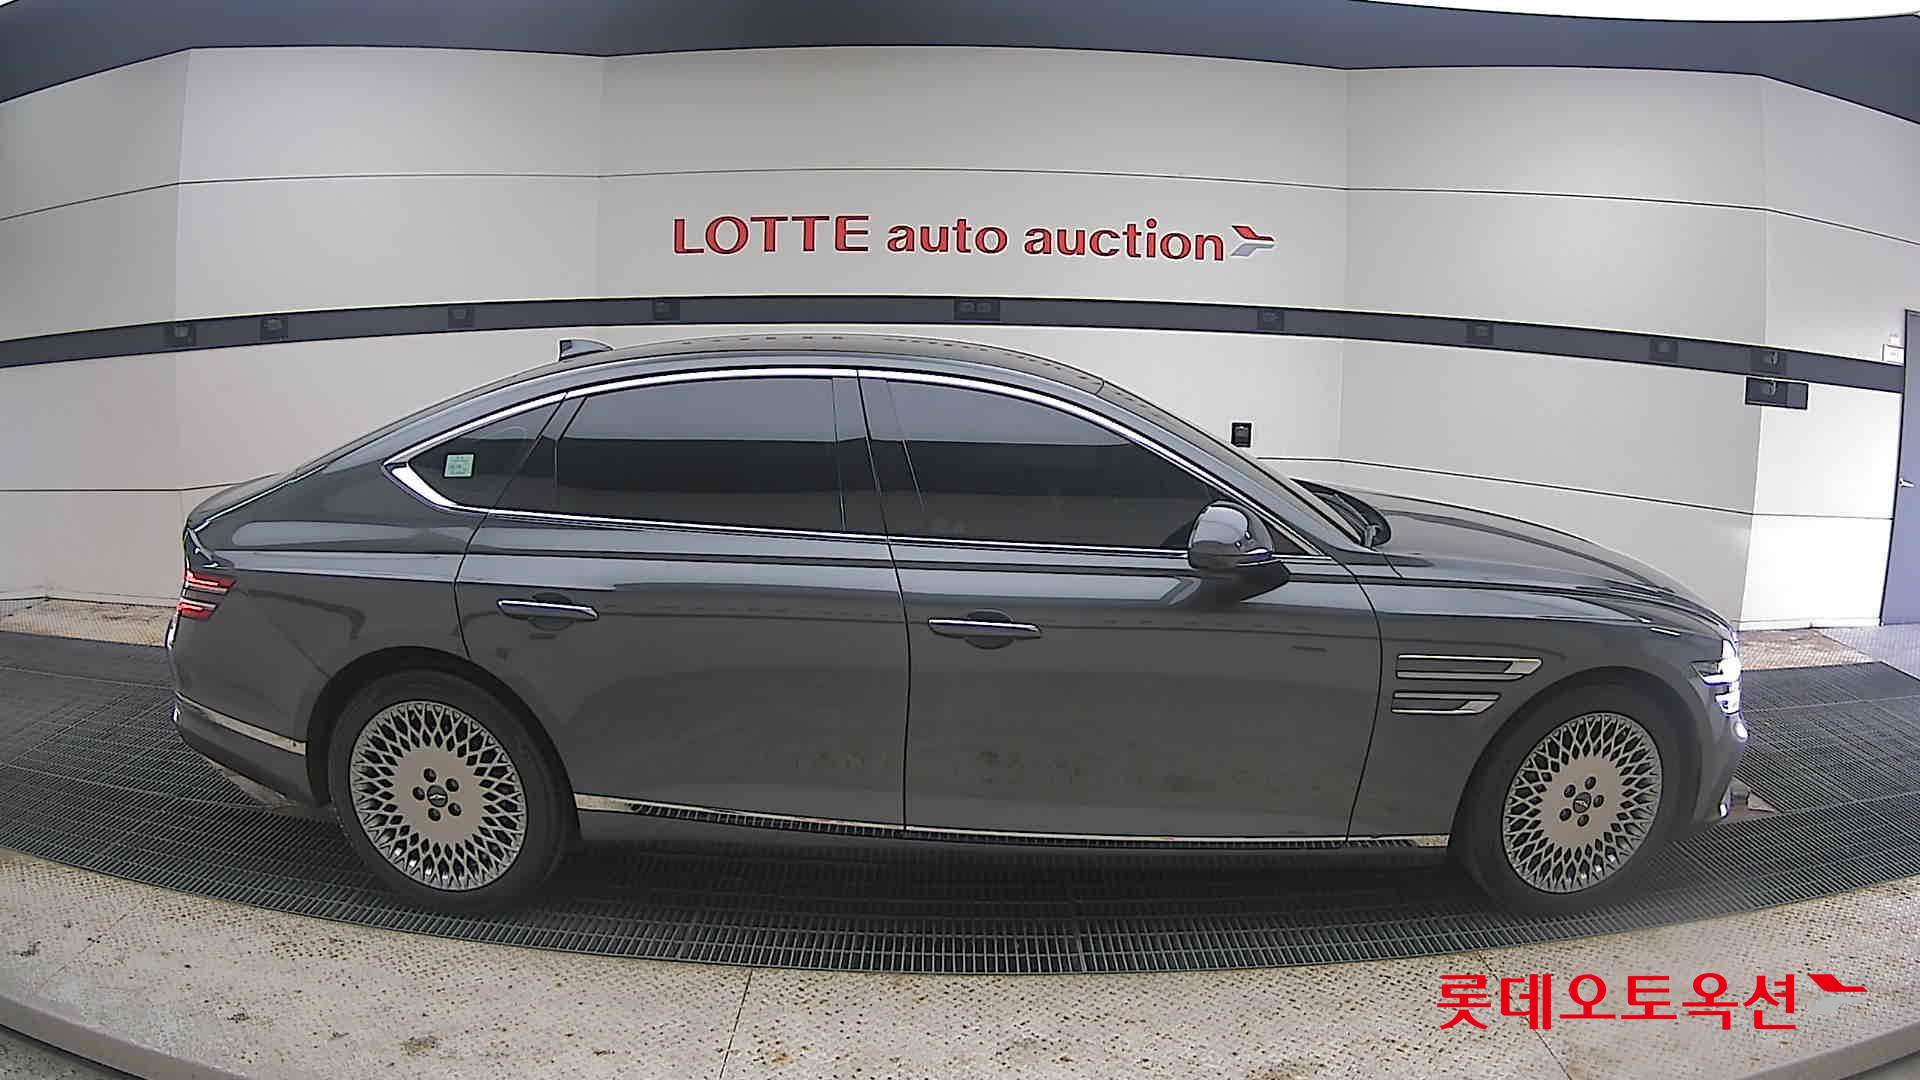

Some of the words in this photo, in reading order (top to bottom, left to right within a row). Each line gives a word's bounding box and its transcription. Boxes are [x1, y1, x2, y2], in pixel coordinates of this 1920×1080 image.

[673, 215, 869, 254] LOTTE
[887, 218, 1008, 254] auto
[1024, 218, 1225, 261] auction
